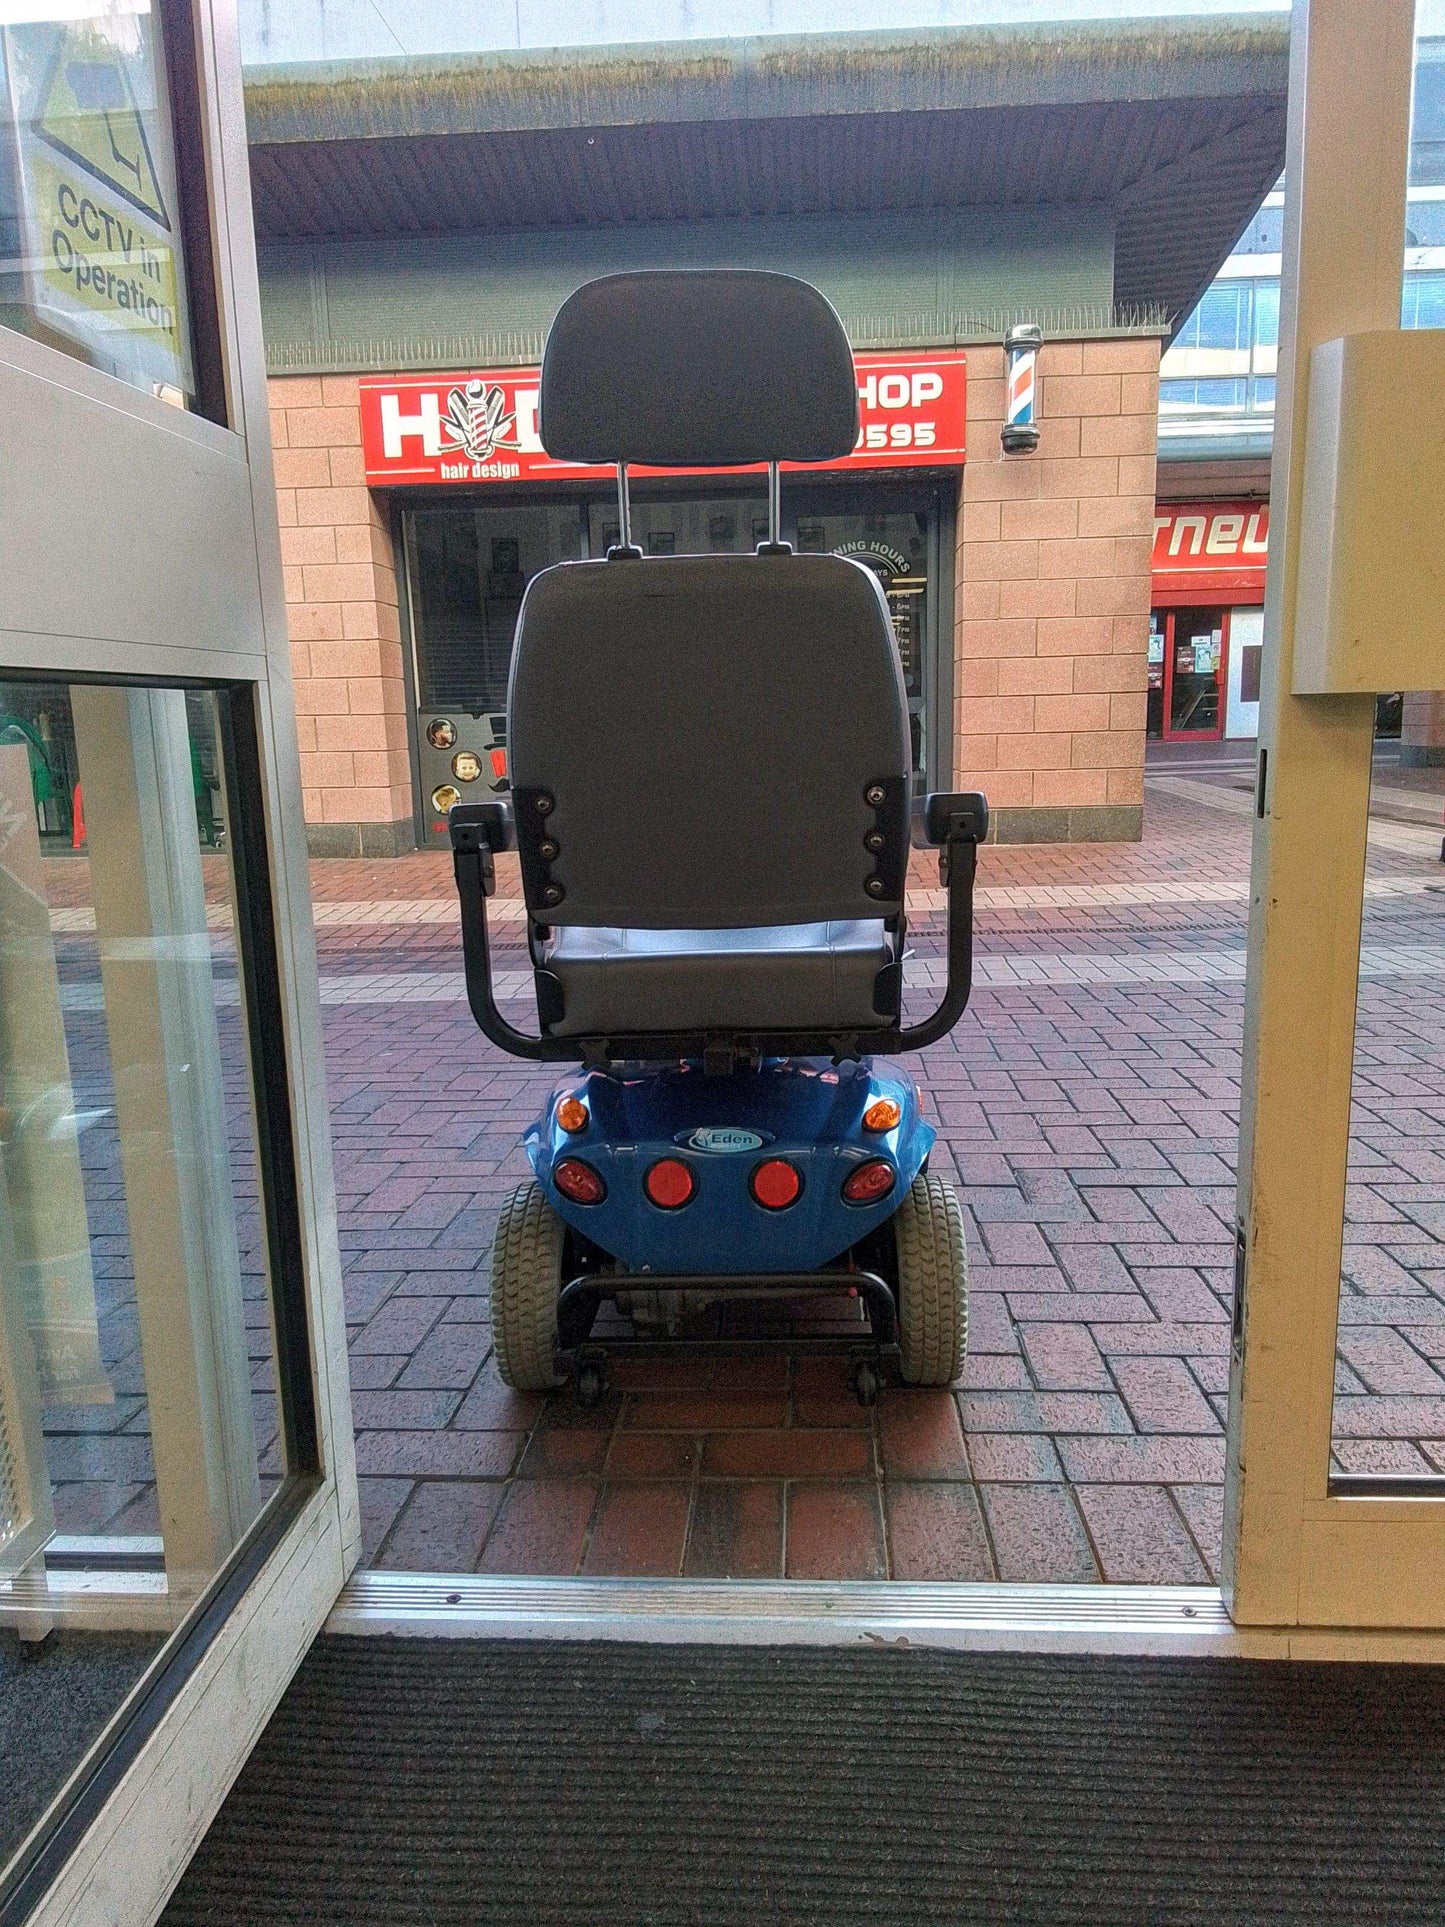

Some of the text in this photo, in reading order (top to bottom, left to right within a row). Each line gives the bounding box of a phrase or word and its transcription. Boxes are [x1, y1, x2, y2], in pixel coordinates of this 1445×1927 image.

[58, 183, 160, 283] CCTV in
[52, 229, 173, 336] Operation
[440, 461, 520, 479] hair design
[870, 541, 911, 573] HOURS
[711, 1133, 753, 1144] Eden
